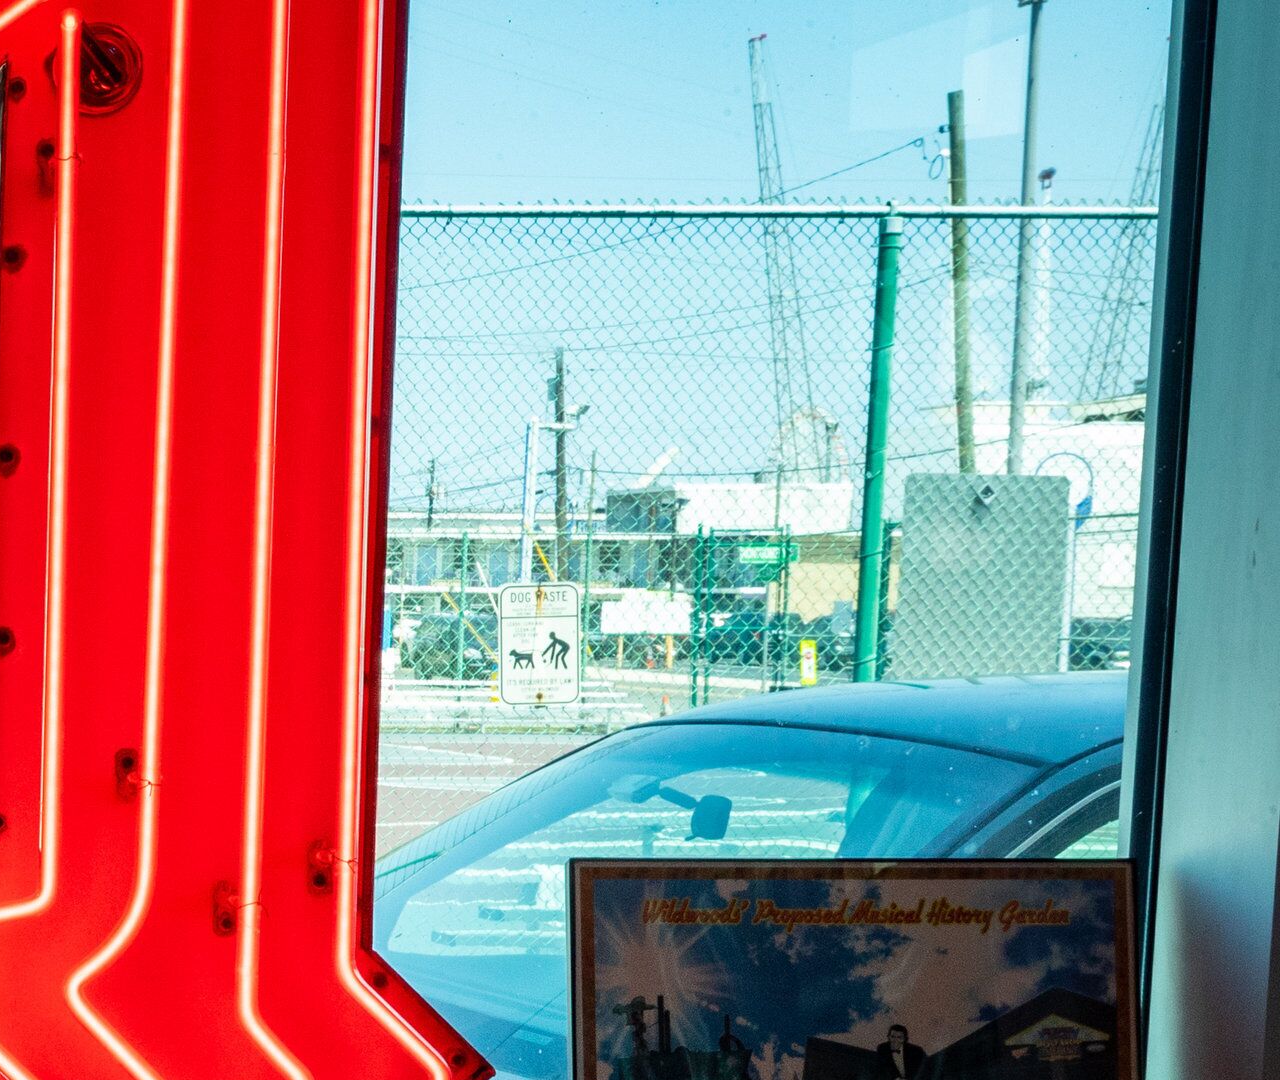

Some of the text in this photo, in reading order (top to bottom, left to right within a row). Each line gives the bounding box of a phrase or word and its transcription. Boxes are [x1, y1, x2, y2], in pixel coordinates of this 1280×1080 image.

[510, 592, 531, 604] DOG
[752, 898, 845, 933] Proposed
[845, 898, 923, 926] Musical
[925, 898, 993, 935] History
[996, 899, 1071, 928] Garden
